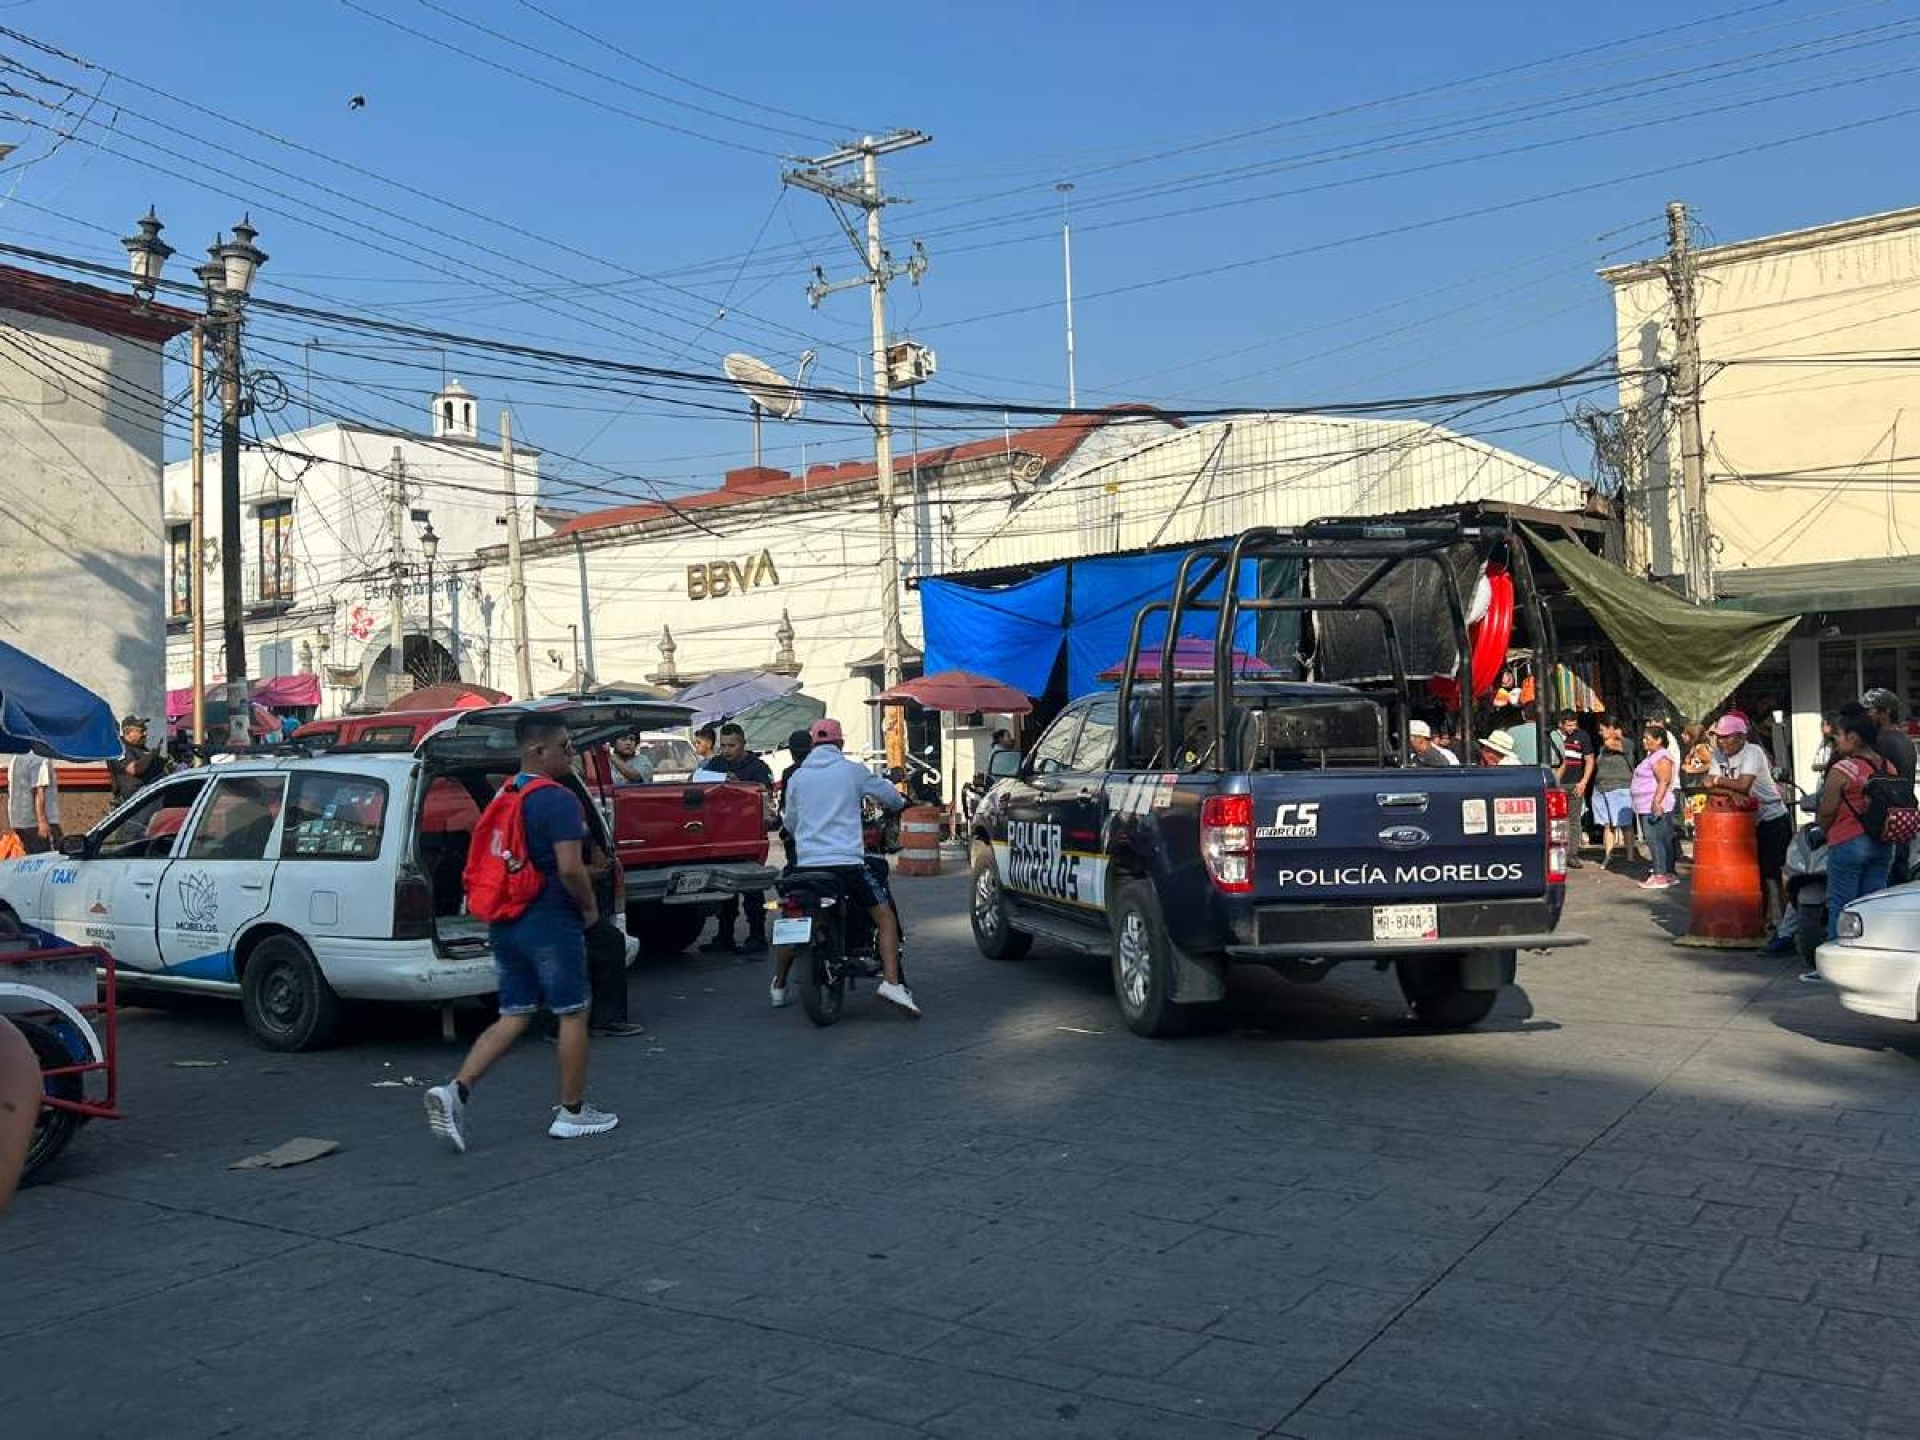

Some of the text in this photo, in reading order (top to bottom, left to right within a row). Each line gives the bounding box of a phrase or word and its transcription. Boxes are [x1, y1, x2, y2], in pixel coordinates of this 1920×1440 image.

[687, 549, 779, 600] BBVA
[51, 869, 77, 884] TAXI
[1279, 863, 1523, 886] POLICÍA MORELOS
[85, 928, 115, 940] MORELOS
[176, 921, 218, 932] MORELOS
